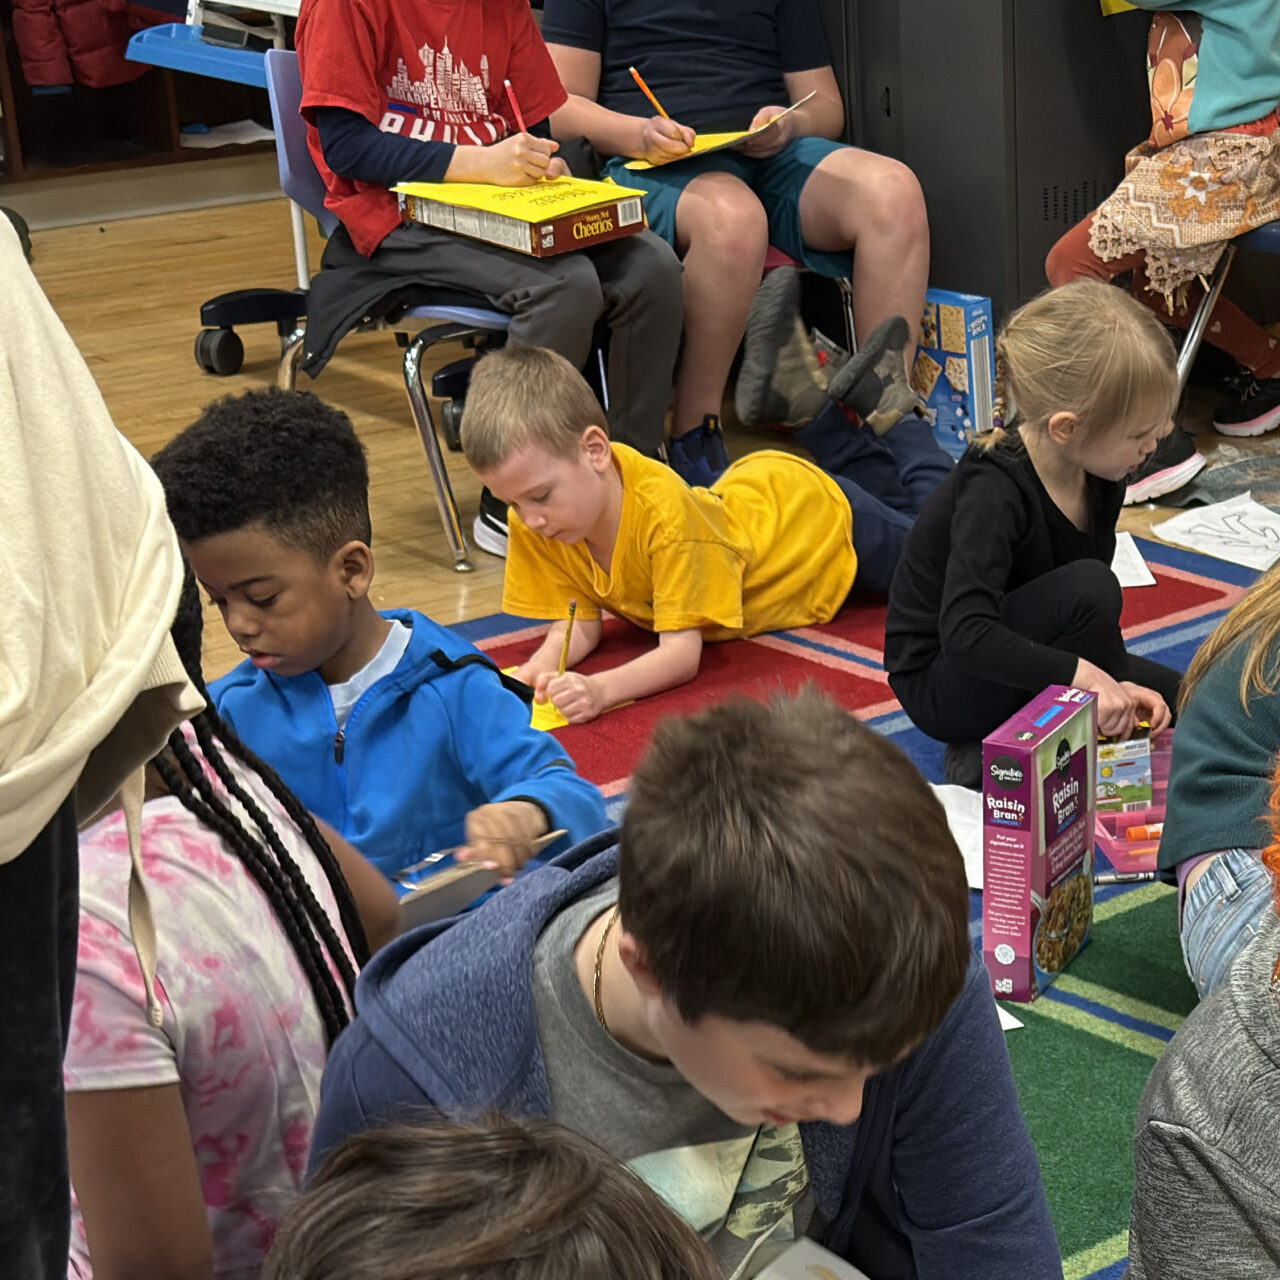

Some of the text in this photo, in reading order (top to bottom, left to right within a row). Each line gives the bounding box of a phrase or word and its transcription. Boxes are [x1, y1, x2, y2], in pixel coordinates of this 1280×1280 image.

[572, 217, 614, 240] Cheerios
[990, 764, 1024, 781] Signature
[986, 796, 1026, 814] Raisin
[1051, 777, 1080, 815] Raisin
[993, 809, 1018, 821] Bran
[1056, 800, 1076, 825] Bran
